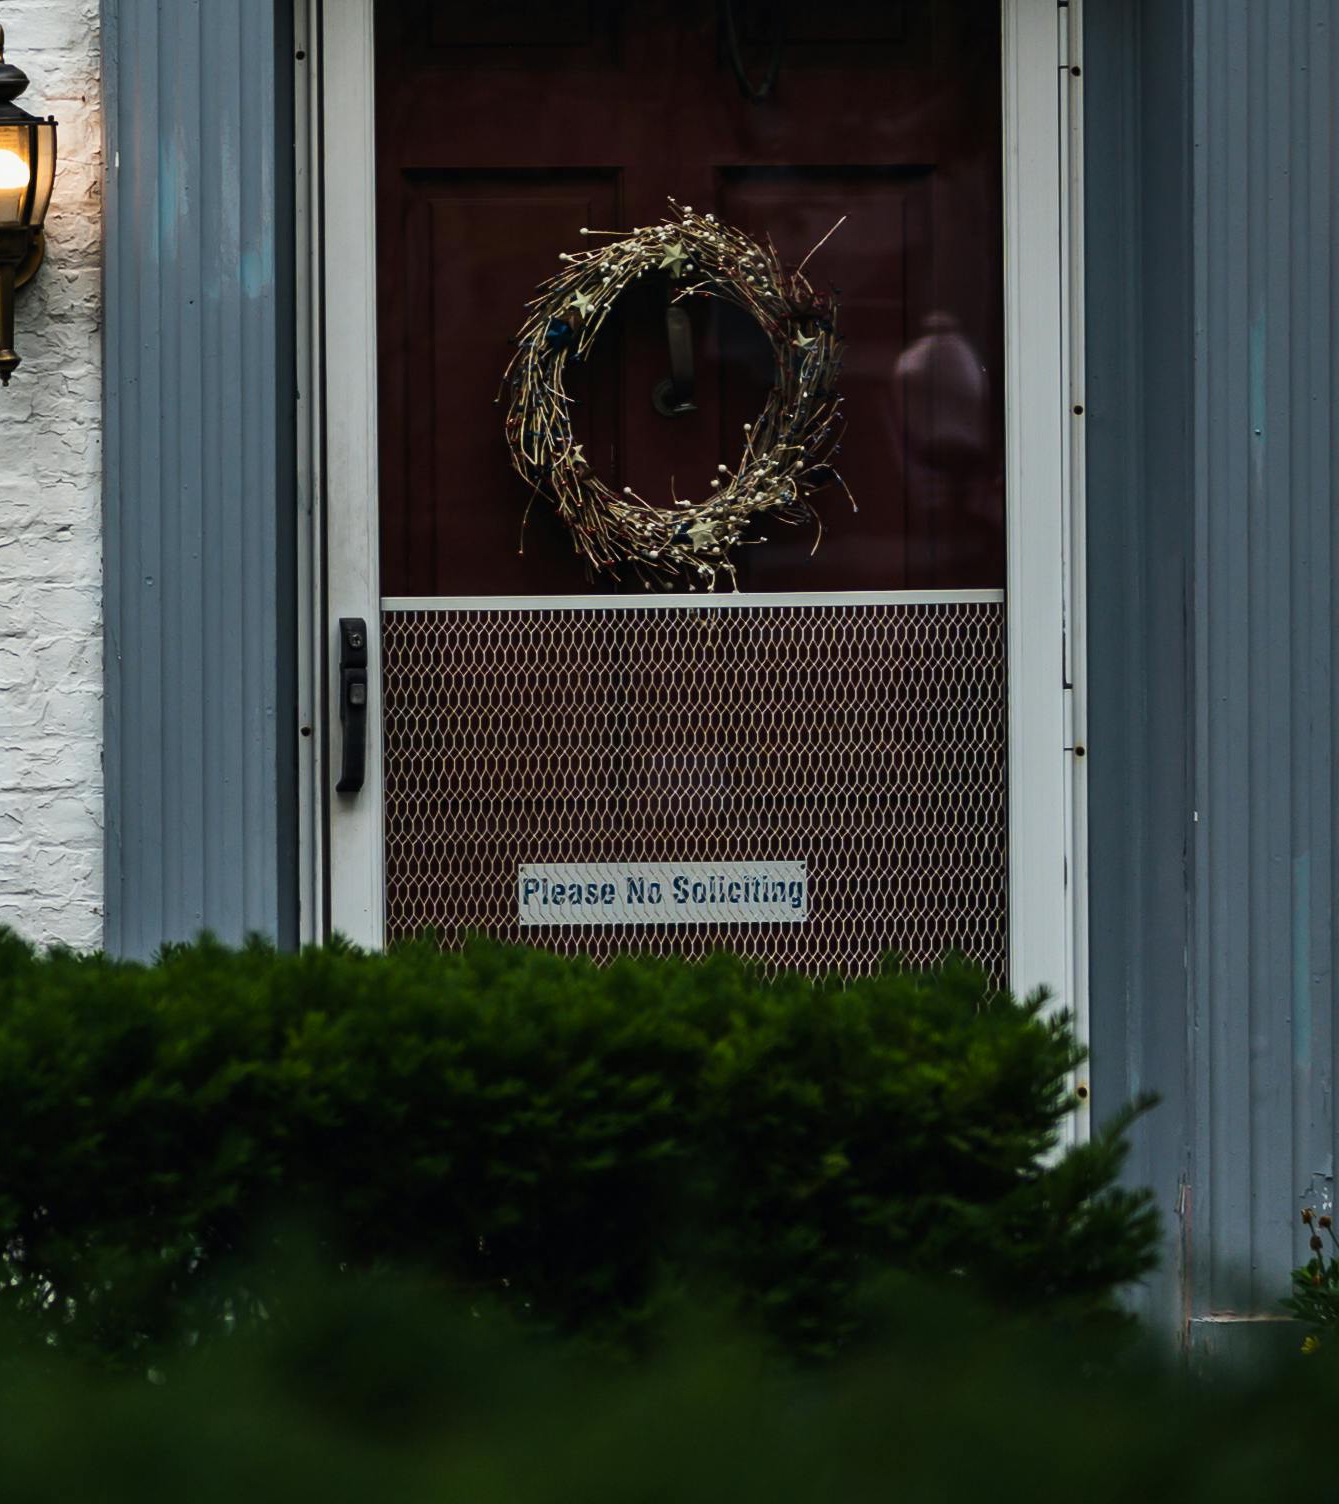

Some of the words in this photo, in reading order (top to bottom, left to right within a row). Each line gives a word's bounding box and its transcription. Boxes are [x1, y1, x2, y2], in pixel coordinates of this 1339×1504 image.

[523, 877, 616, 906] Please
[626, 876, 663, 905] No
[672, 874, 804, 909] Soliciting
